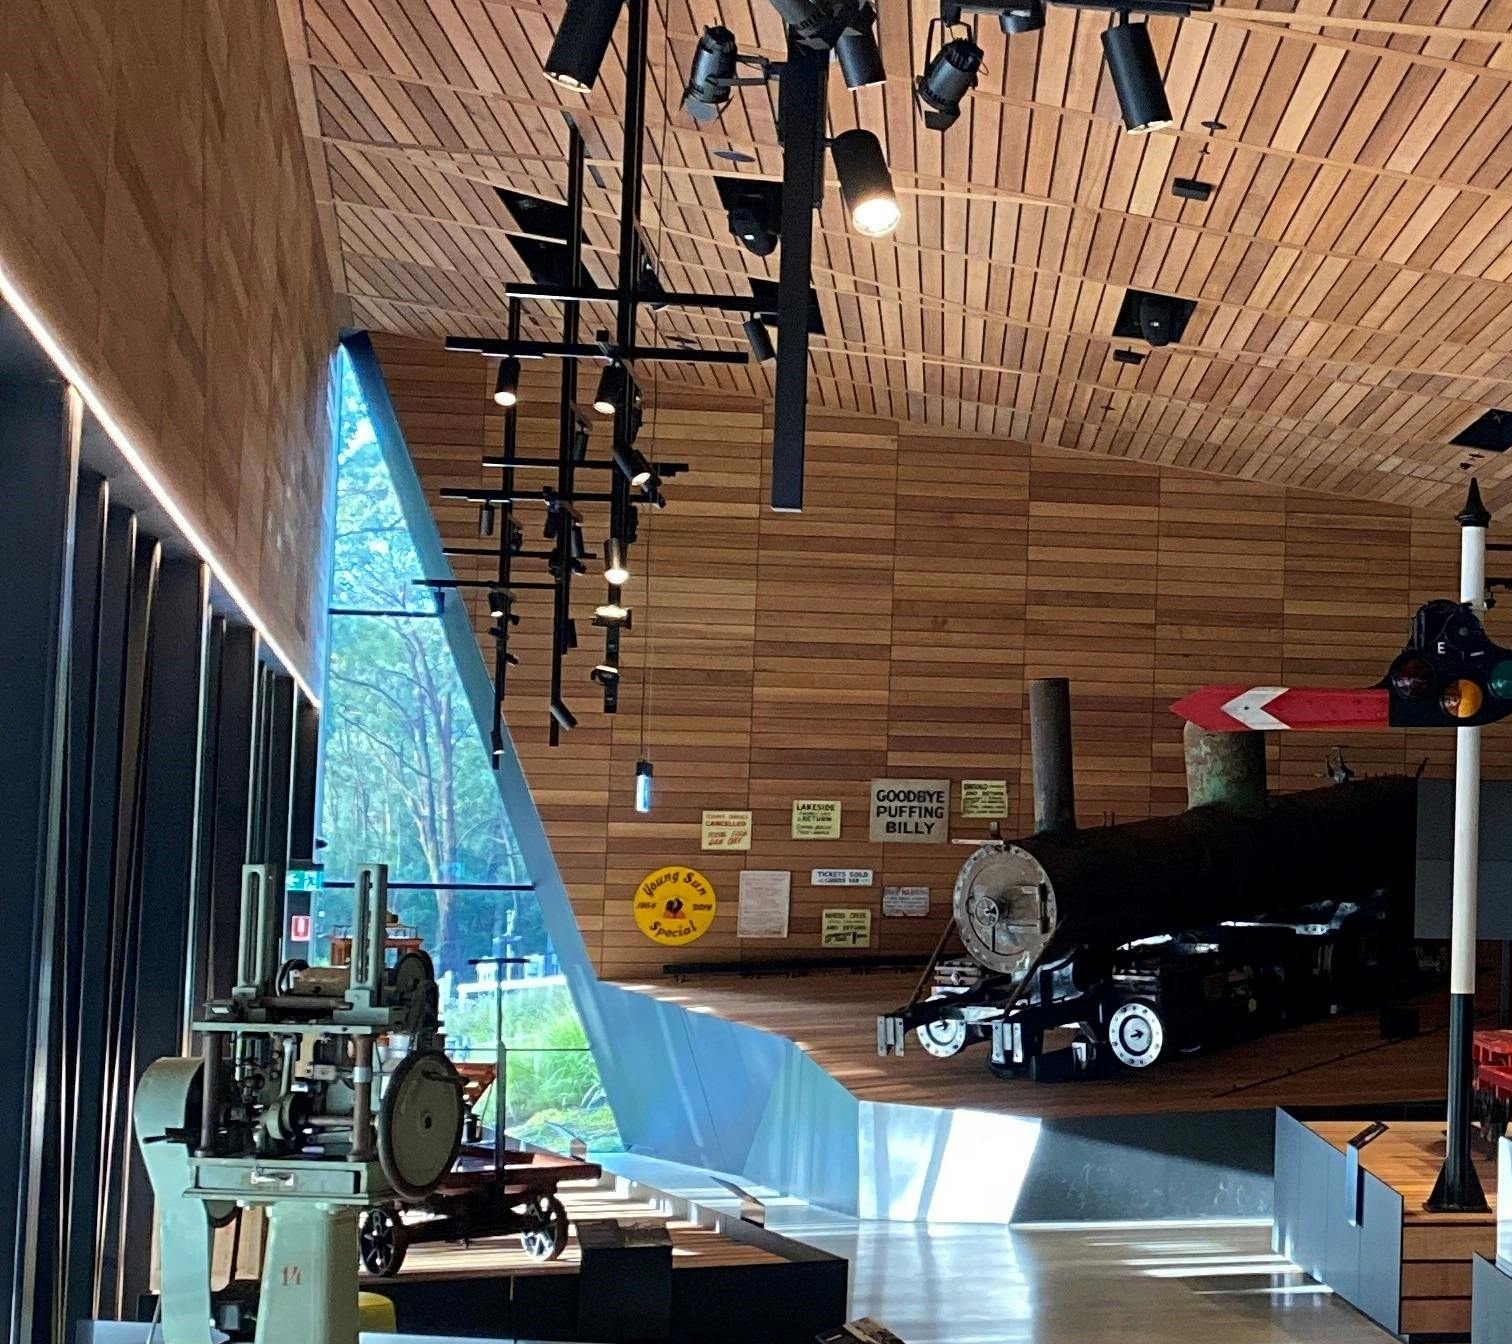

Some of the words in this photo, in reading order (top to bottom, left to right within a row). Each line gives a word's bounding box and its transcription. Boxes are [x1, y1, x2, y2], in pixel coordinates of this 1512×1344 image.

[1437, 641, 1447, 655] E
[876, 789, 946, 803] GOODBYE
[796, 803, 836, 811] LAKESIDE
[876, 805, 944, 819] PUFFING
[885, 821, 936, 834] BILLY
[642, 871, 680, 898] Young
[683, 871, 708, 896] Sun
[650, 919, 697, 938] Special
